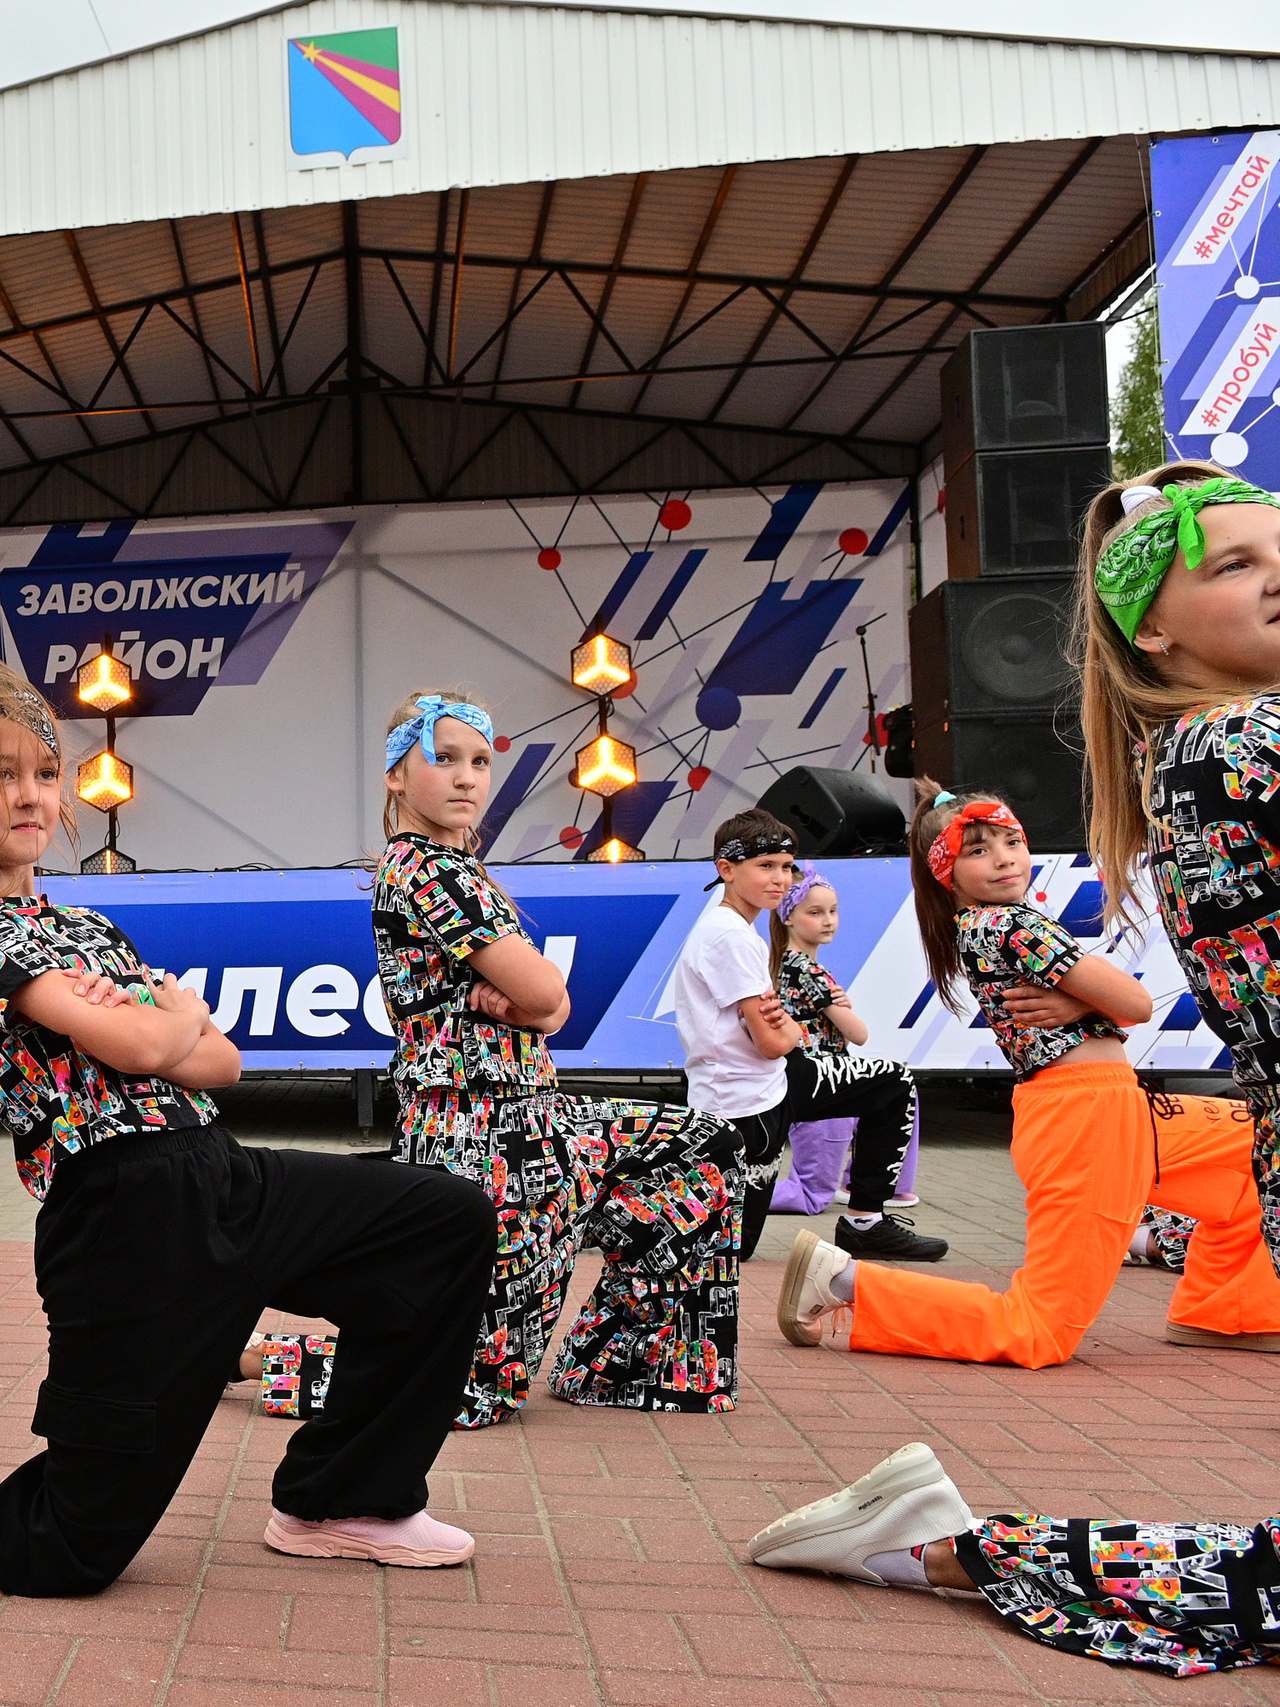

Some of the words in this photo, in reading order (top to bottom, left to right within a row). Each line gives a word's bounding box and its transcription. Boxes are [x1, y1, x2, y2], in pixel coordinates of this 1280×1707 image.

[1193, 155, 1271, 260] #мечтай
[1201, 322, 1278, 428] #пробуй
[16, 563, 306, 617] ЗАВОЛЖСКИЙ
[1172, 790, 1212, 904] STREET
[414, 881, 472, 933] CITY
